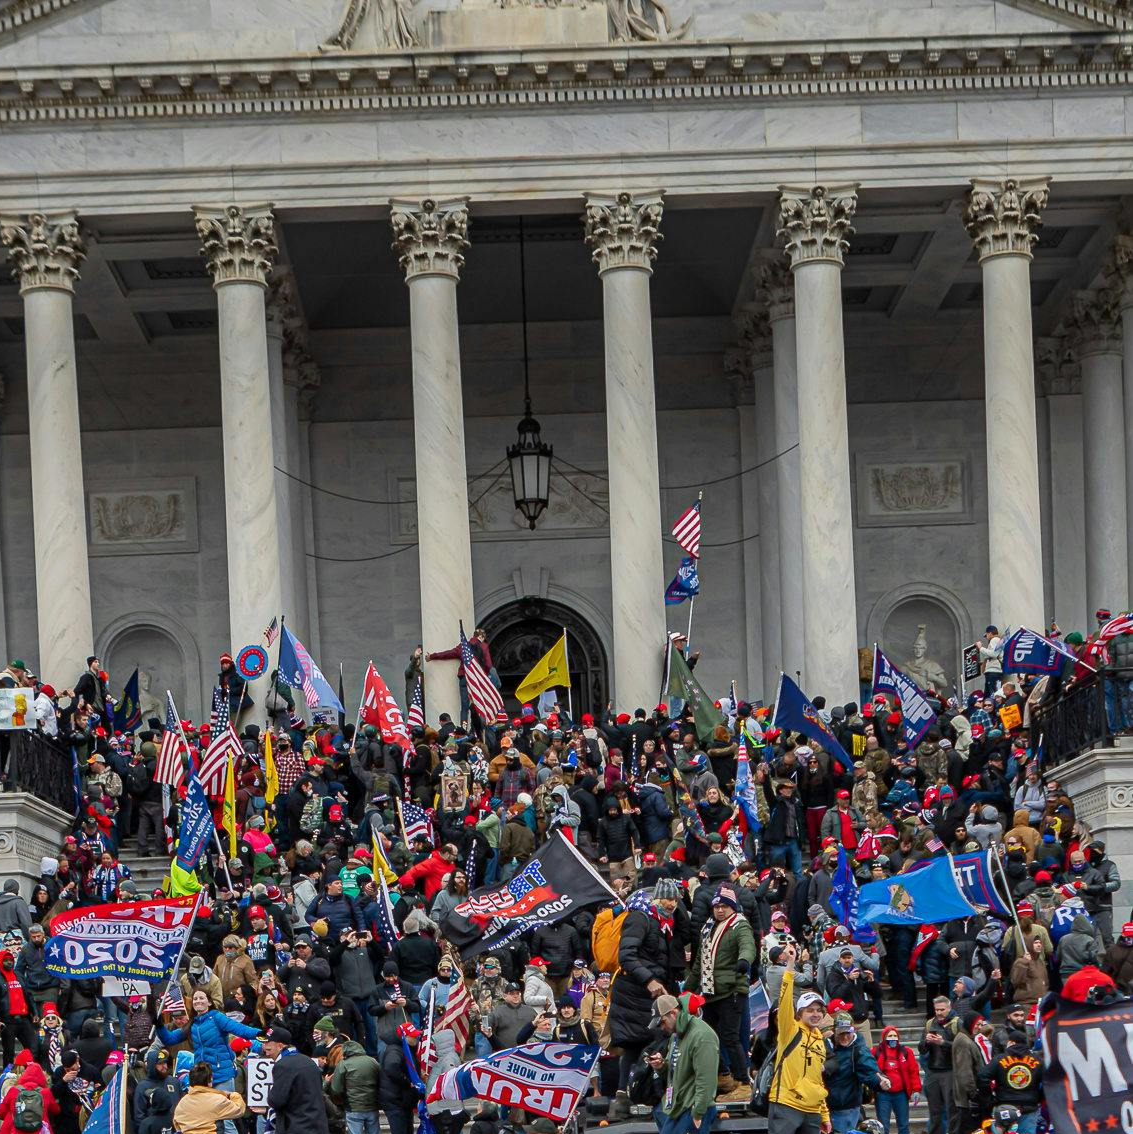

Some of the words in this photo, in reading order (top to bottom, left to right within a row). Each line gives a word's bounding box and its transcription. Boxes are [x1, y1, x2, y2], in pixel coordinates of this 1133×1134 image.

[122, 982, 139, 995] PA
[507, 1061, 537, 1080] MORE
[540, 1072, 556, 1082] NO
[470, 1070, 574, 1119] TRUM
